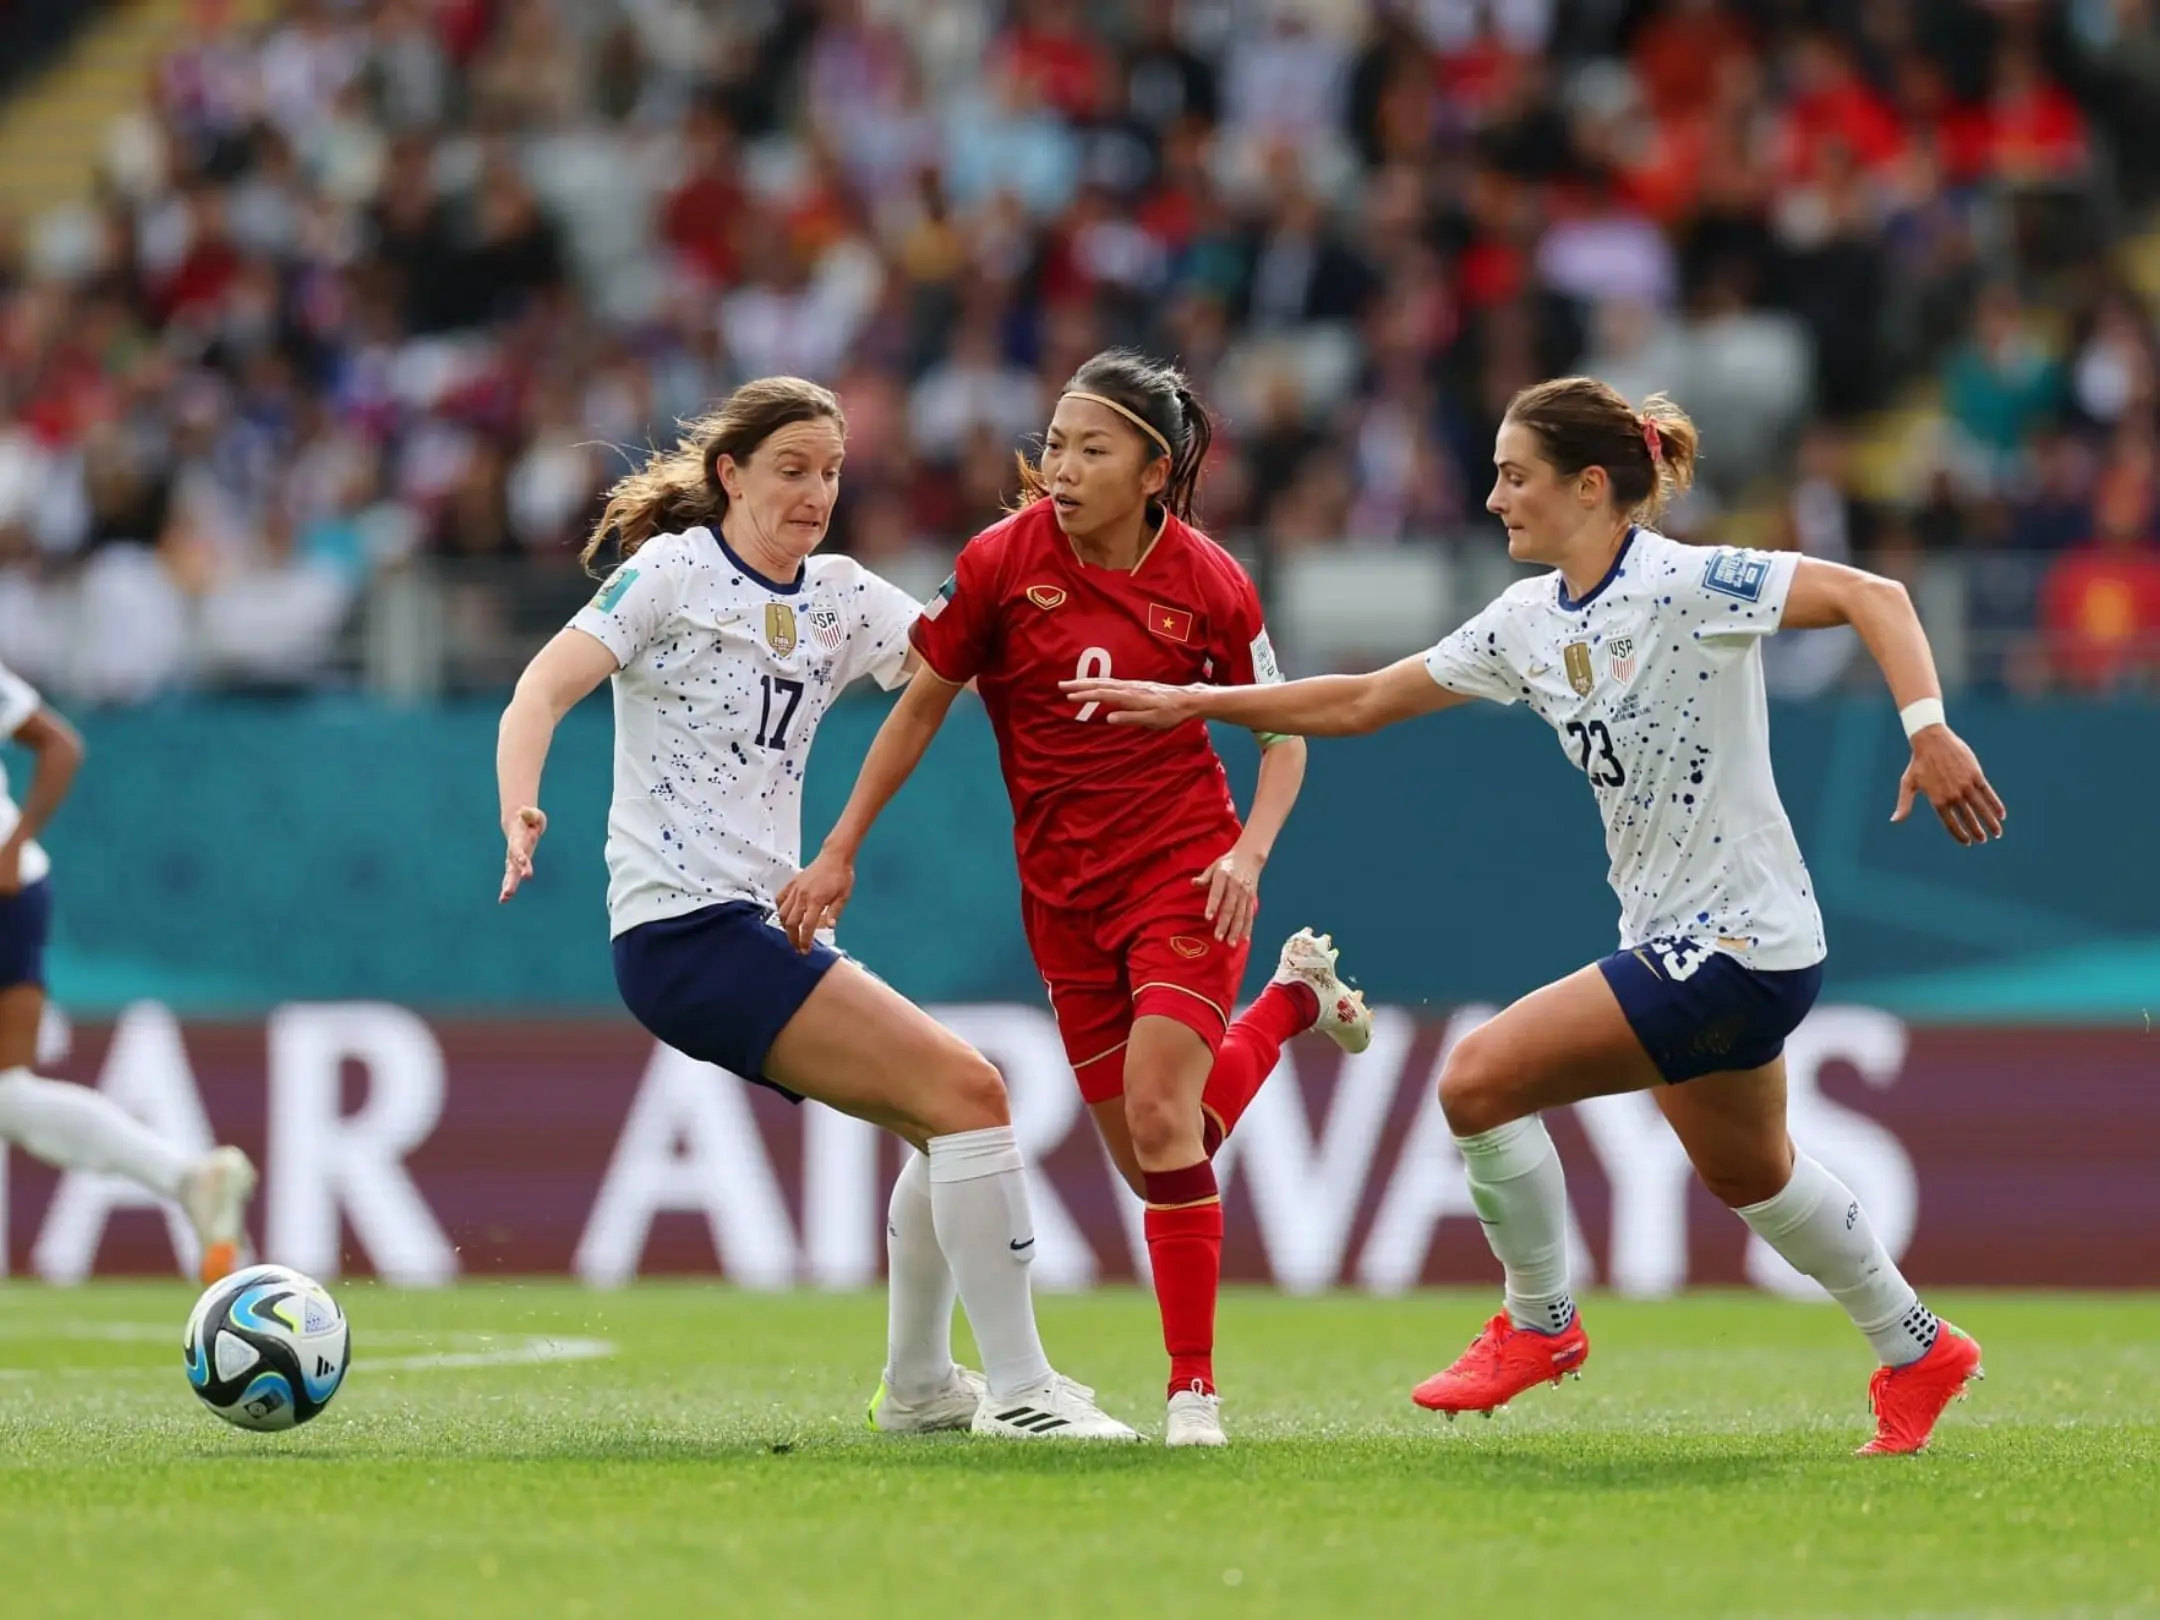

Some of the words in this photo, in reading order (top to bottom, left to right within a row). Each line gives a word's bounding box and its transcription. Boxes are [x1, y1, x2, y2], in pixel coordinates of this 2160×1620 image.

[809, 612, 836, 629] USA
[1609, 638, 1633, 658] USA
[754, 675, 805, 751] 17
[1075, 646, 1113, 722] 9
[1566, 719, 1626, 787] 23
[0, 998, 460, 1288] AR
